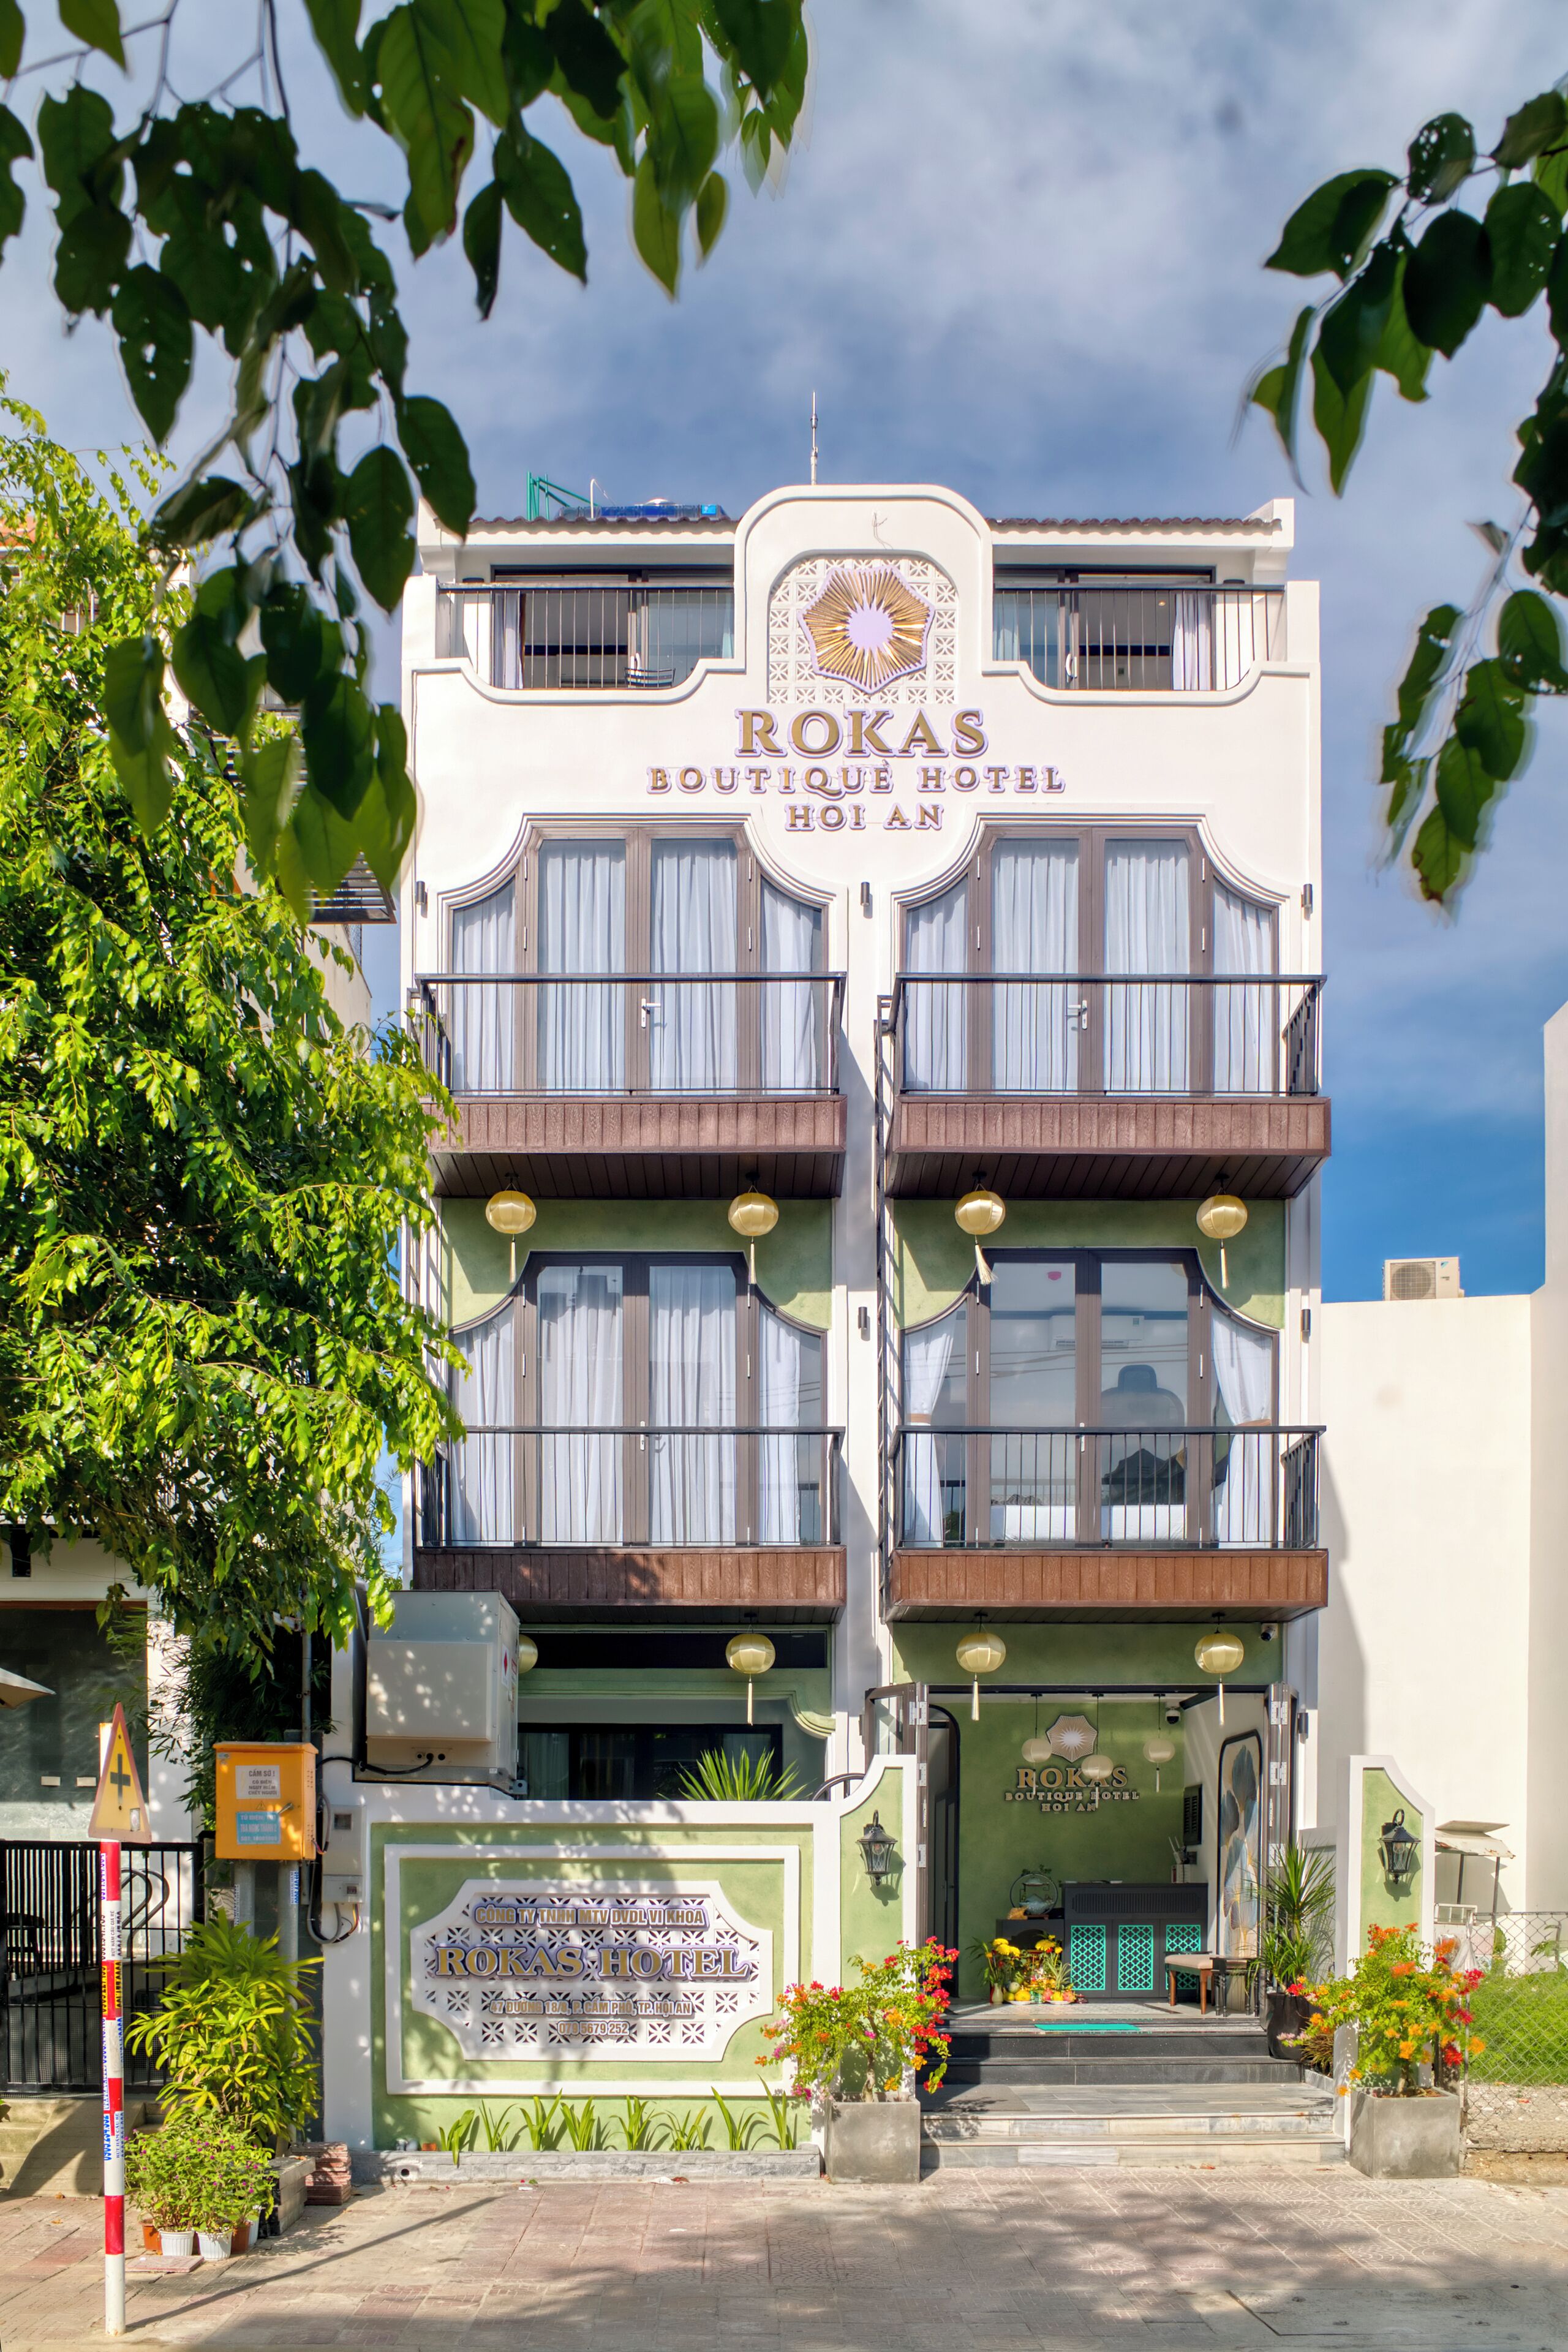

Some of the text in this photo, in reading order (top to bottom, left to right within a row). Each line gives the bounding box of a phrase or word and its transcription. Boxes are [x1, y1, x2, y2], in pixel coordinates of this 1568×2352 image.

[736, 709, 987, 756] ROKAS
[649, 766, 1064, 797] BOUTIQUE HOTEL
[786, 804, 943, 831] HOI AN
[1005, 1791, 1139, 1802] BOUTIQUE HOTEL
[1041, 1803, 1069, 1812] HOI
[477, 1905, 704, 1924] CÔNG TY TNHH MTV DVDL VI KHOA
[437, 1947, 750, 1978] ROKAS HOTEL
[491, 2001, 503, 2013] 47
[506, 1997, 543, 2013] ĐƯỜNG
[573, 2001, 582, 2013] P.
[638, 2002, 652, 2013] TP.
[656, 2000, 673, 2016] HỘI
[676, 2003, 690, 2013] AN
[559, 2022, 628, 2034] 079 5679 252
